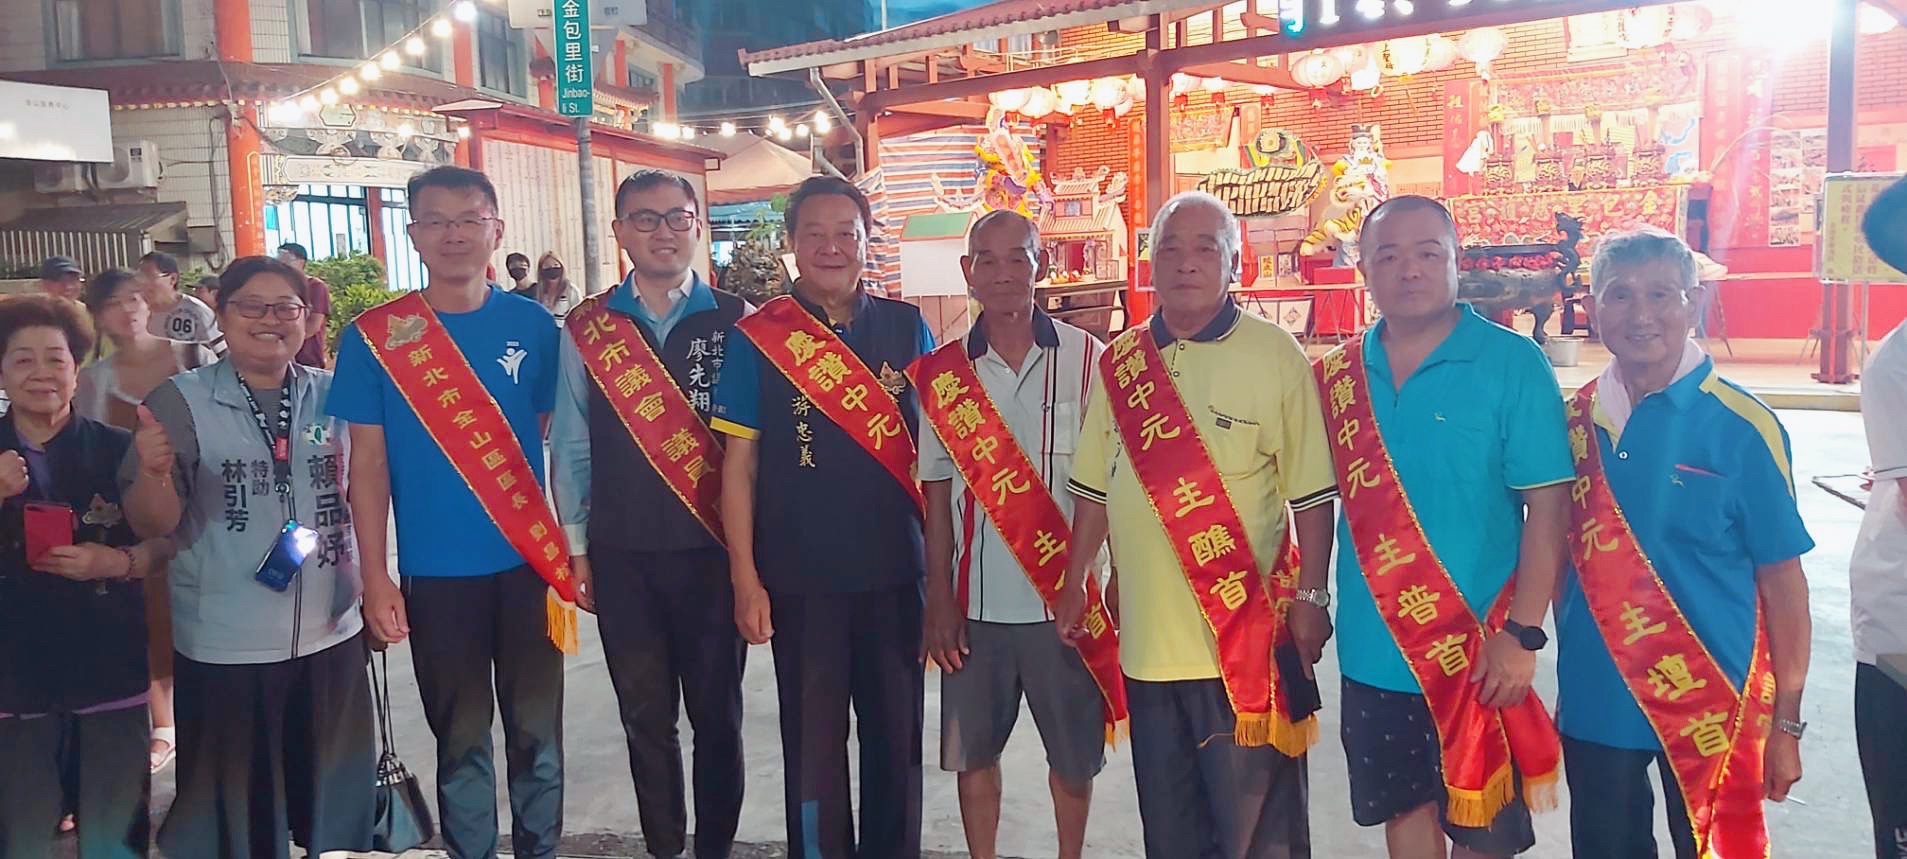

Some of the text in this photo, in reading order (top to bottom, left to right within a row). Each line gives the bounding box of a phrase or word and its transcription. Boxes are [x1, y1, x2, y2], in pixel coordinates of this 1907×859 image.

[562, 0, 584, 84] 金包里街
[562, 88, 590, 98] Jinbao-
[172, 317, 193, 333] 06
[686, 338, 711, 413] 廖先翔
[784, 329, 901, 451] 慶讚中元
[221, 458, 249, 532] 林引芳
[251, 459, 270, 497] 特助
[660, 427, 717, 489] 議員
[1110, 330, 1181, 451] 慶讚中元
[1171, 476, 1249, 611] 主醮首
[930, 371, 1107, 640] 慶讚中元 主首
[1323, 349, 1470, 678] 慶讚中元 主普首
[1618, 600, 1732, 757] 主壇首
